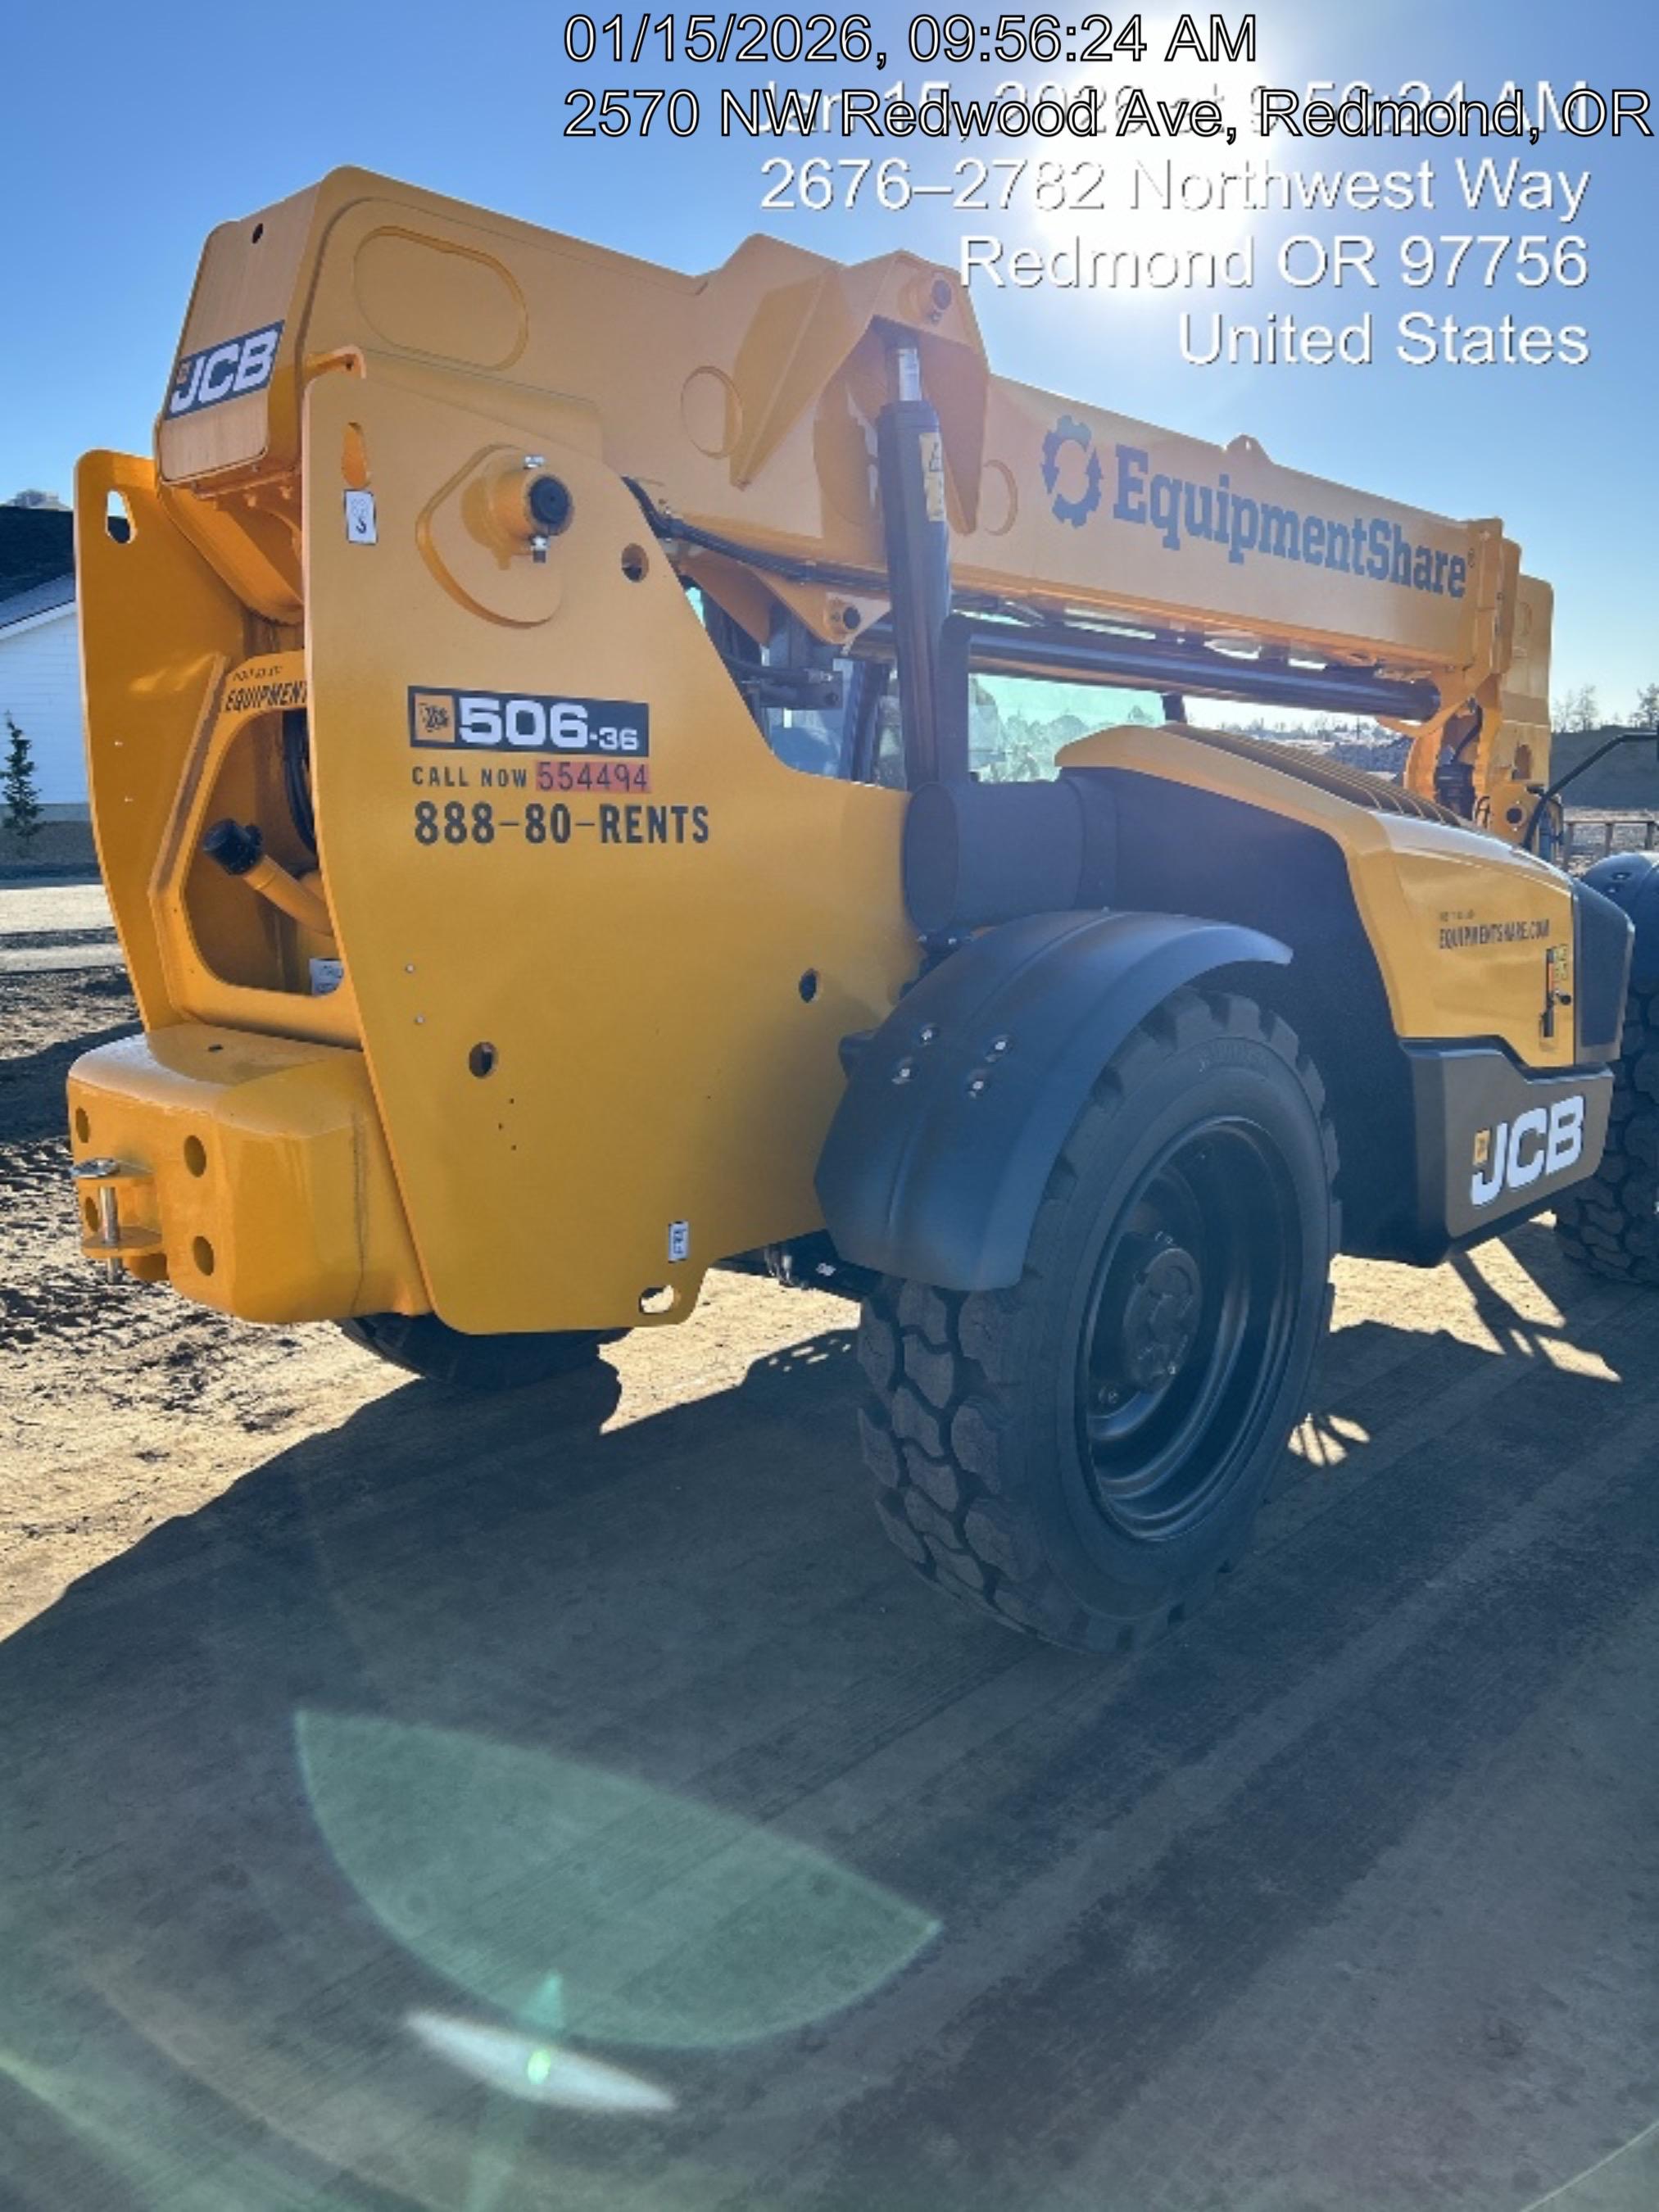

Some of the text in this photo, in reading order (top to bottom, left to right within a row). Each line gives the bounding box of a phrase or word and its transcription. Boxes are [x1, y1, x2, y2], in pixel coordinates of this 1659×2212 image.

[170, 329, 279, 415] JCB
[1113, 443, 1466, 600] EquipmentShare
[411, 765, 528, 789] CALL NOW
[537, 761, 648, 792] 554494
[414, 800, 710, 846] 888-80-RENTS
[1470, 1095, 1584, 1207] JCB
